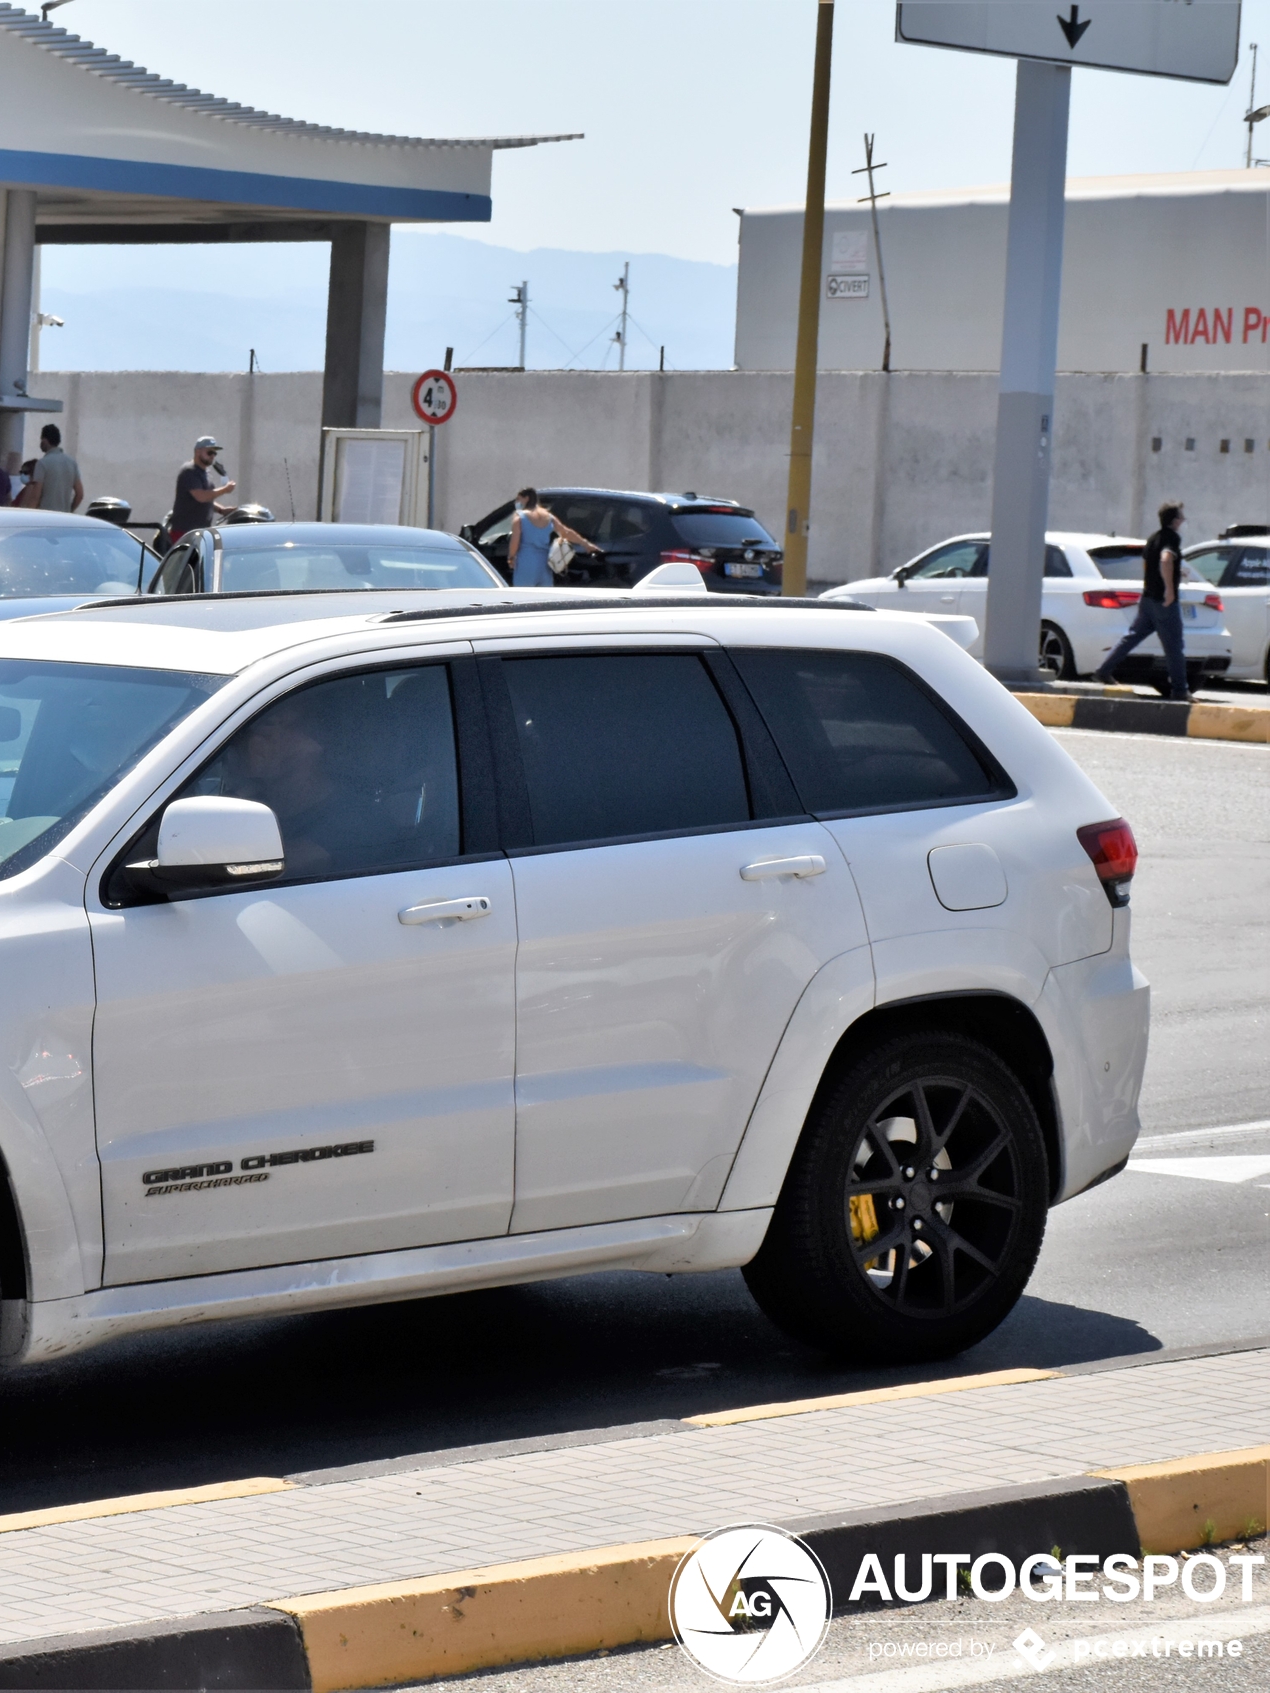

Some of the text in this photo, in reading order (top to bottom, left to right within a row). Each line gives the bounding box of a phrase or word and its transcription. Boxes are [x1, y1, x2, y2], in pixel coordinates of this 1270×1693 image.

[1165, 307, 1233, 345] MAN
[423, 387, 433, 408] 4
[142, 1140, 375, 1185] GRAND CHEROKEE
[144, 1172, 271, 1197] SUPERCHARGED
